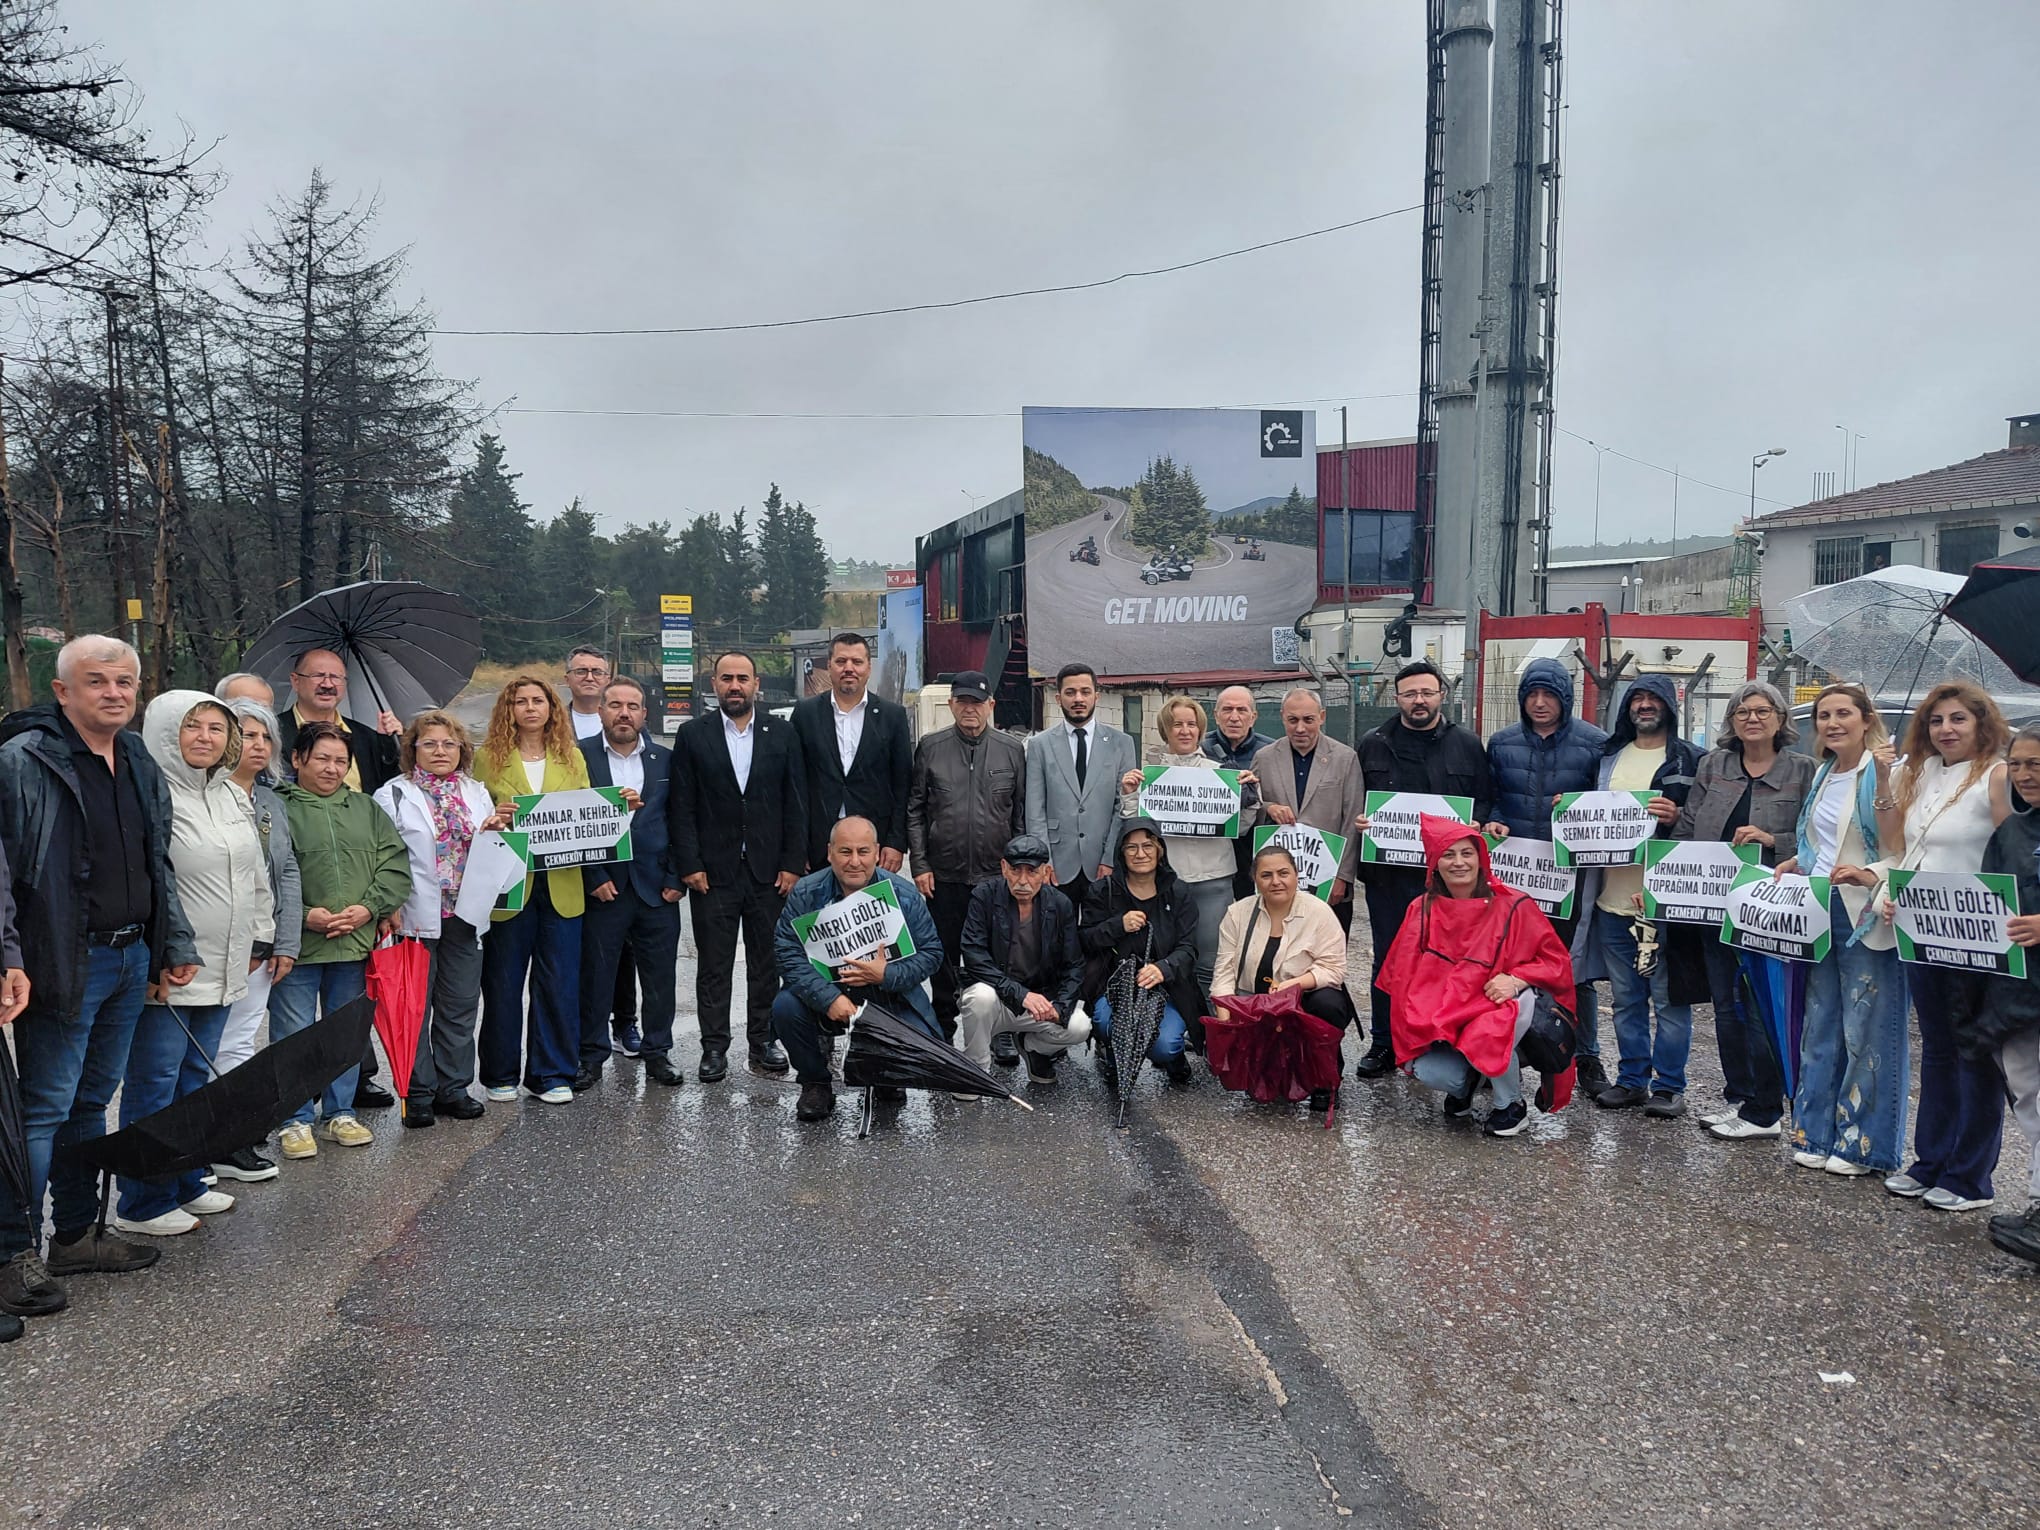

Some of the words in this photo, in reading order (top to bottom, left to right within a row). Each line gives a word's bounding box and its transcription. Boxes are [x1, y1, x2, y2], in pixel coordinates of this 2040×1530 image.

[1104, 597, 1151, 625] GET
[1153, 595, 1248, 623] MOVING
[1148, 784, 1195, 799] ORMANIMA,
[1198, 786, 1232, 800] SUYUMA
[519, 809, 577, 828] ORMANLAR,
[580, 803, 624, 821] NEHİRLER
[1144, 799, 1189, 813] TOPRAĞIMA
[1192, 801, 1235, 815] DOKUNMA!
[1557, 808, 1607, 823] ORMANLAR,
[575, 822, 620, 840] DEĞİLDİR!
[1161, 822, 1196, 834] ÇEKMEKÖY
[1197, 825, 1216, 835] HALKI
[544, 850, 583, 868] ÇEKMEKÖY
[585, 848, 607, 860] HALKI
[1654, 862, 1706, 879] ORMANIMA,
[1709, 864, 1737, 879] SUYU
[1648, 878, 1698, 895] TOPRAĞIMA
[1896, 882, 1950, 912] ÖMERLİ
[1954, 887, 2008, 916] GÖLETİ
[806, 911, 852, 943] ÖMERLİ
[850, 893, 891, 926] GÖLETİ
[1665, 905, 1705, 920] ÇEKMEKÖY
[1739, 902, 1808, 937] DOKUNMA!
[1914, 913, 1999, 943] HALKINDIR!
[824, 920, 889, 960] HALKINDIR!
[1780, 942, 1803, 956] HALKI
[1925, 946, 1969, 965] ÇEKMEKÖY
[1971, 952, 1997, 969] HALKI
